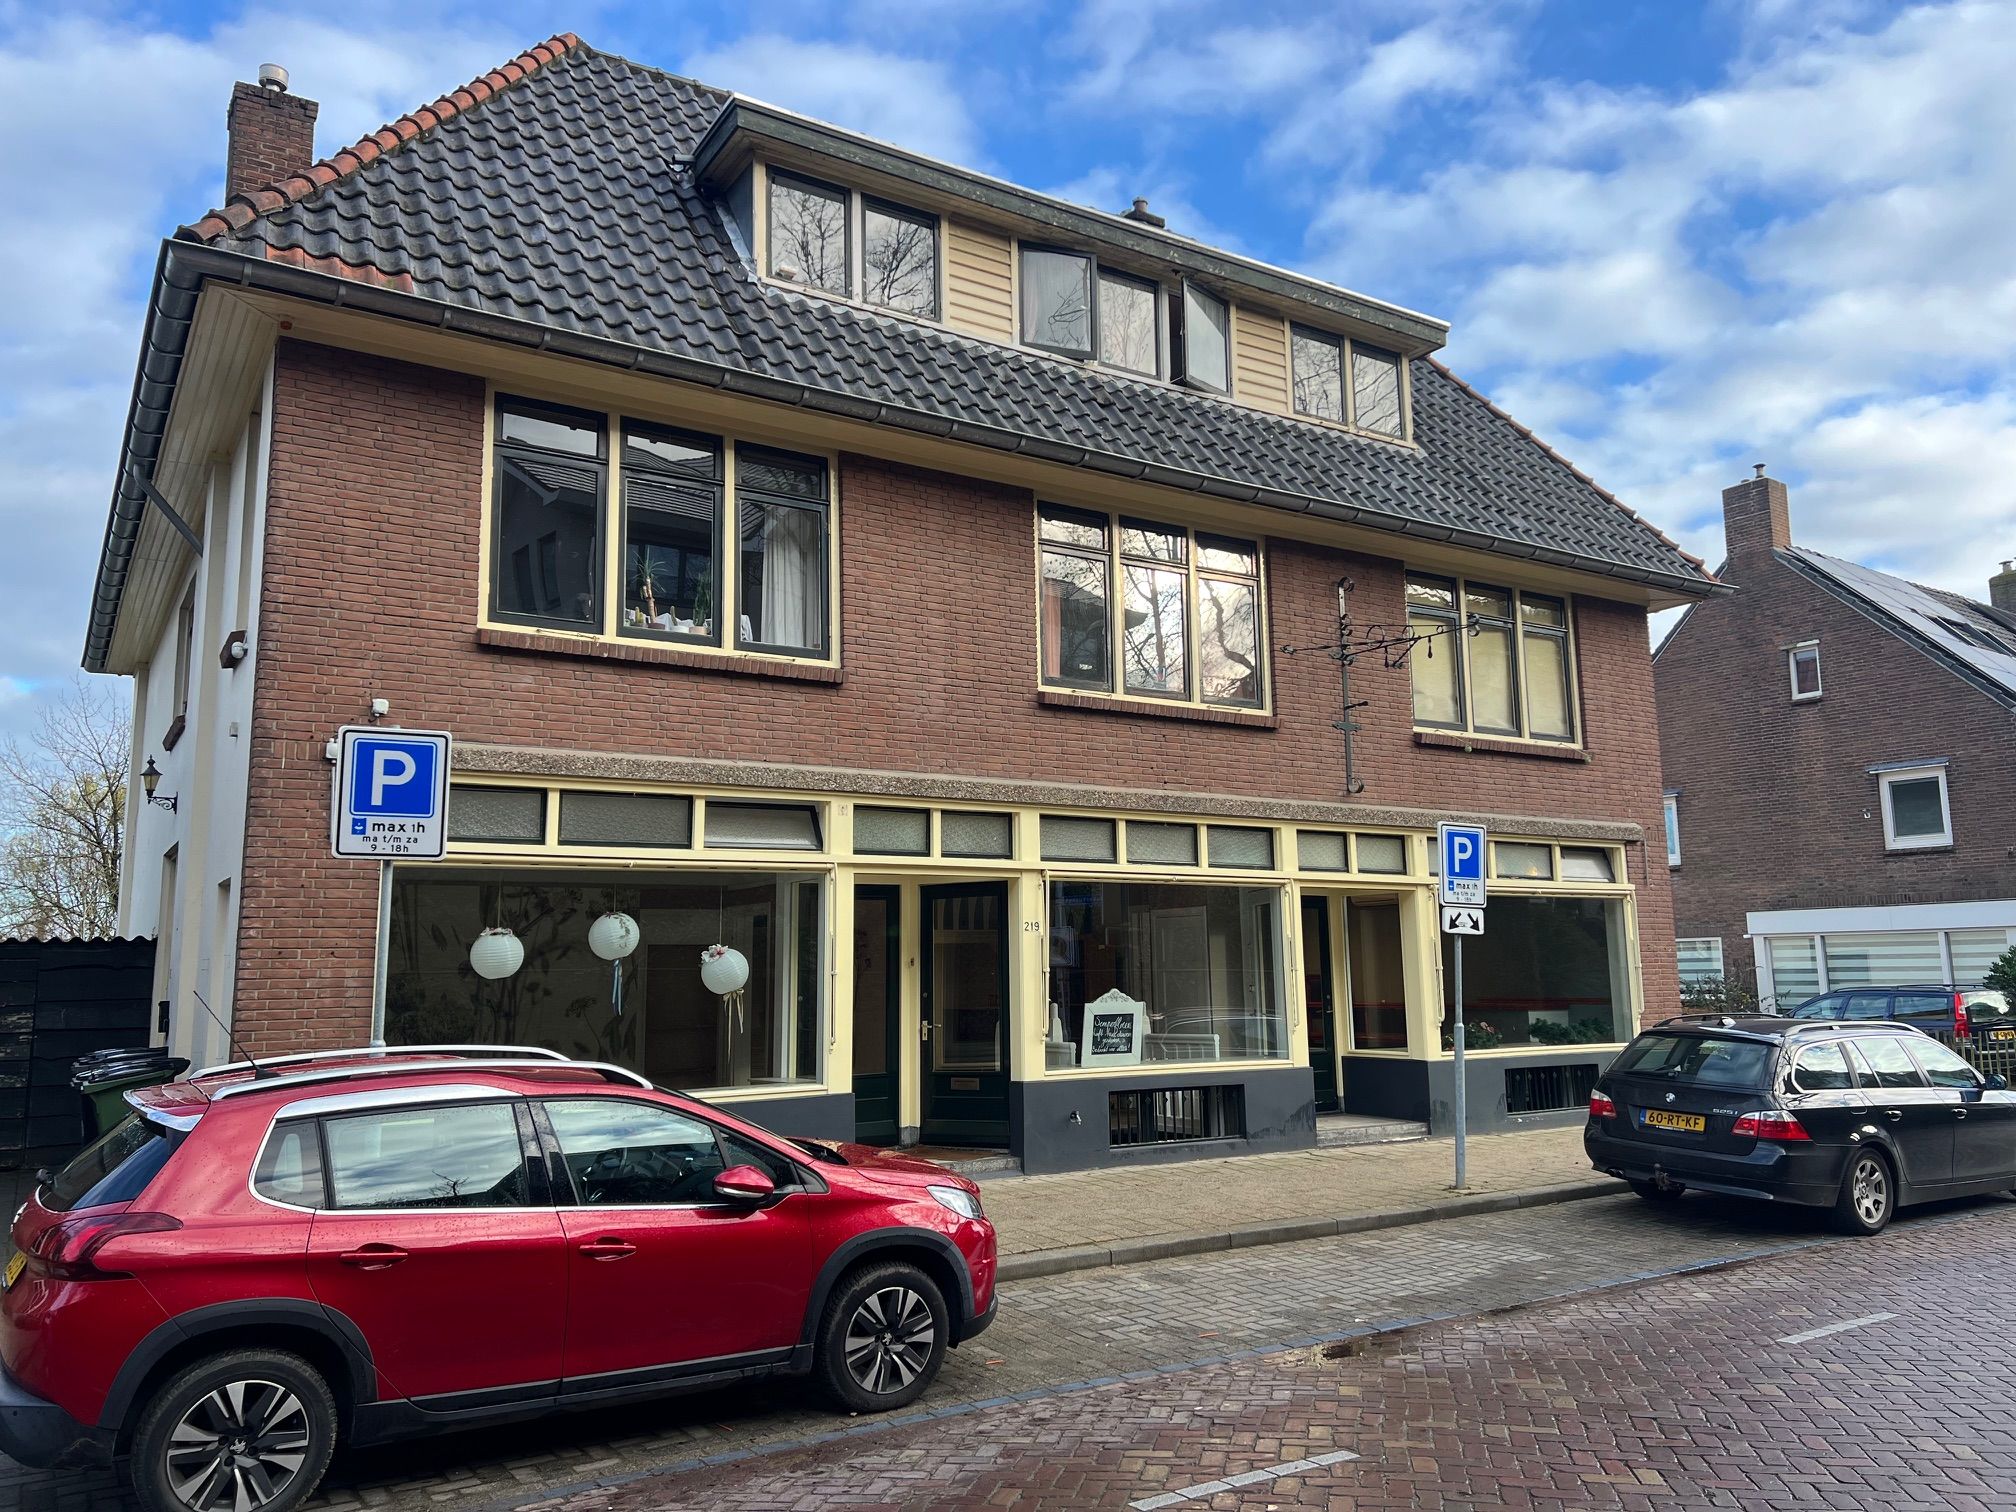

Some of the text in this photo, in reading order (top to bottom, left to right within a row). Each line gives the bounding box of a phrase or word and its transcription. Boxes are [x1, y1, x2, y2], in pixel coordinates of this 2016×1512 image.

[371, 749, 417, 806] P
[372, 822, 406, 833] max
[362, 835, 418, 844] ma t/m za
[391, 844, 409, 853] 18h
[1454, 836, 1473, 873] P
[1024, 921, 1040, 932] 219
[1649, 1112, 1701, 1129] 60-RT-KF
